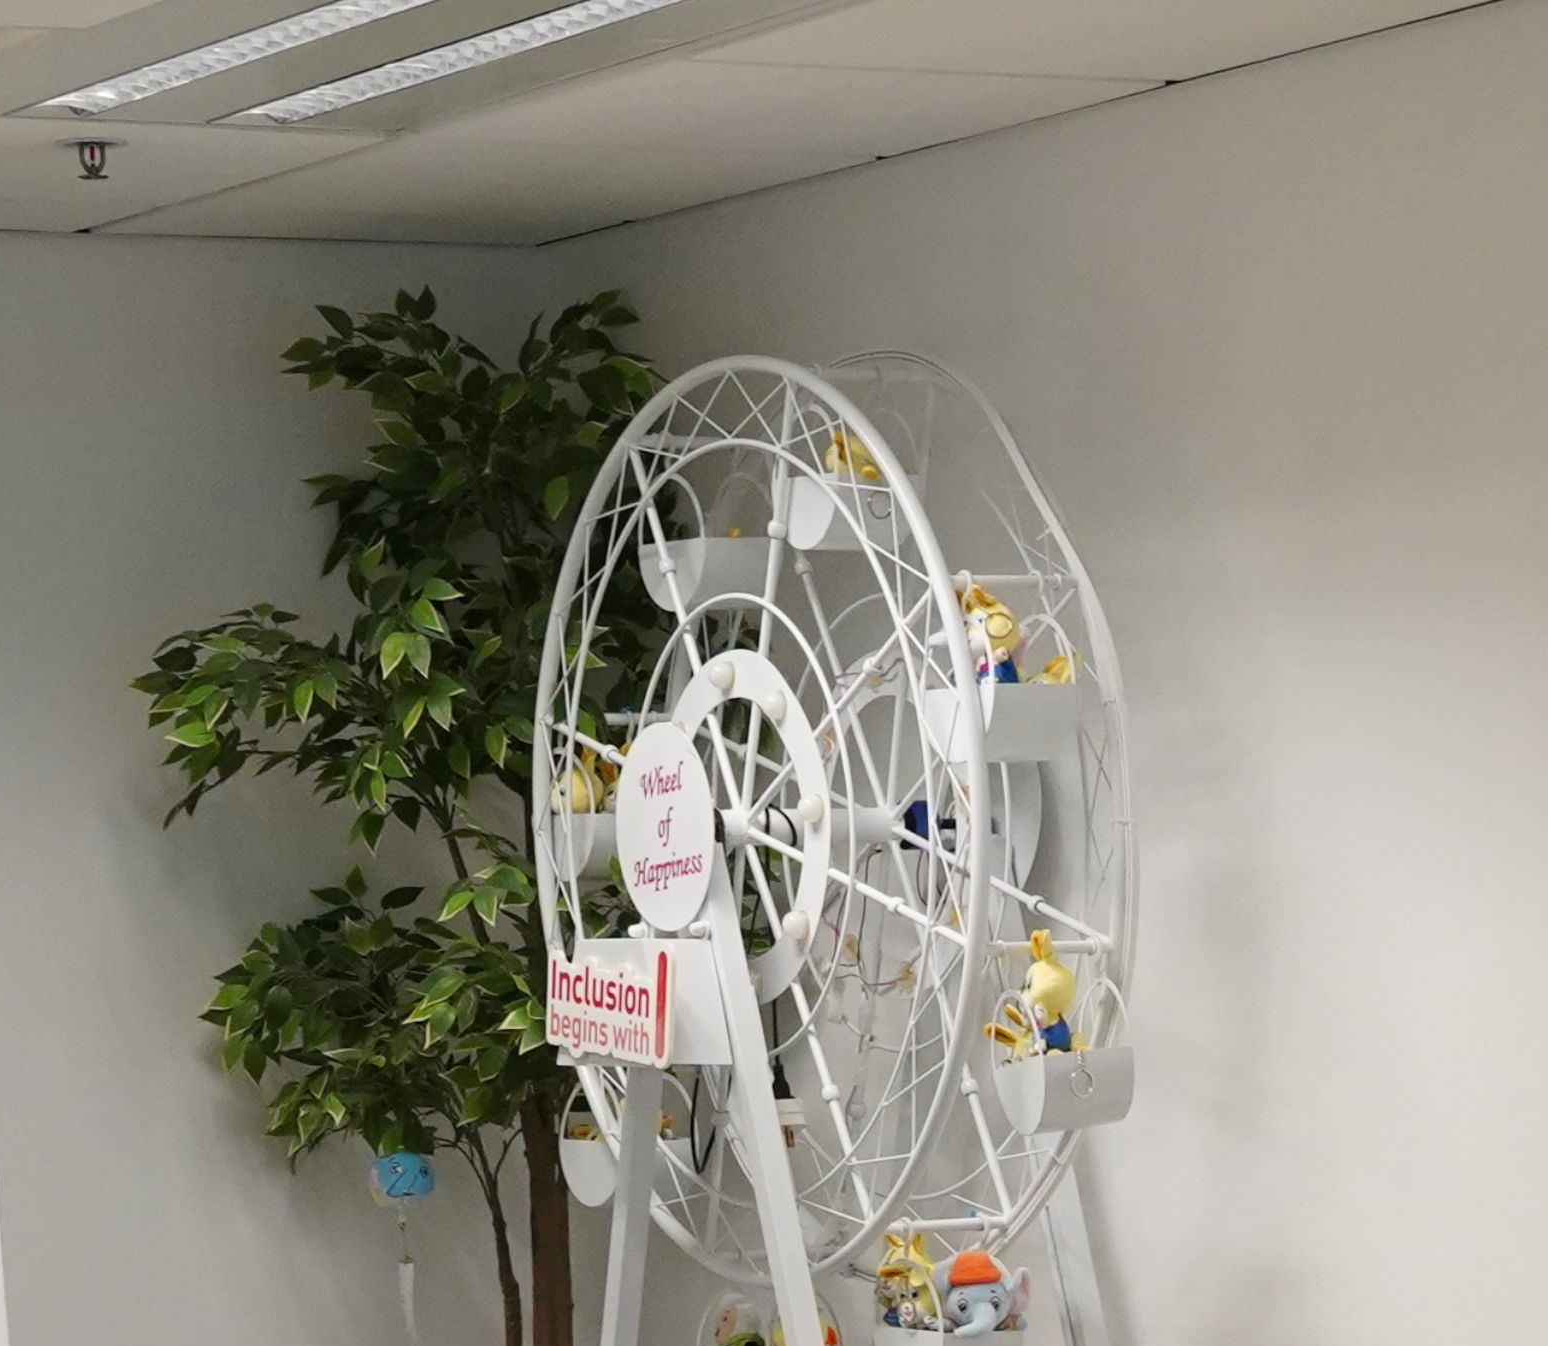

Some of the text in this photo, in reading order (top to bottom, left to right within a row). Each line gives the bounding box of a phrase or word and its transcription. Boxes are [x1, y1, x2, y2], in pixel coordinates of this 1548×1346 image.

[639, 761, 684, 800] Wheel
[657, 806, 672, 847] of
[633, 851, 703, 892] Happiness
[550, 959, 651, 1018] Inclusion
[550, 1004, 651, 1057] begins with
